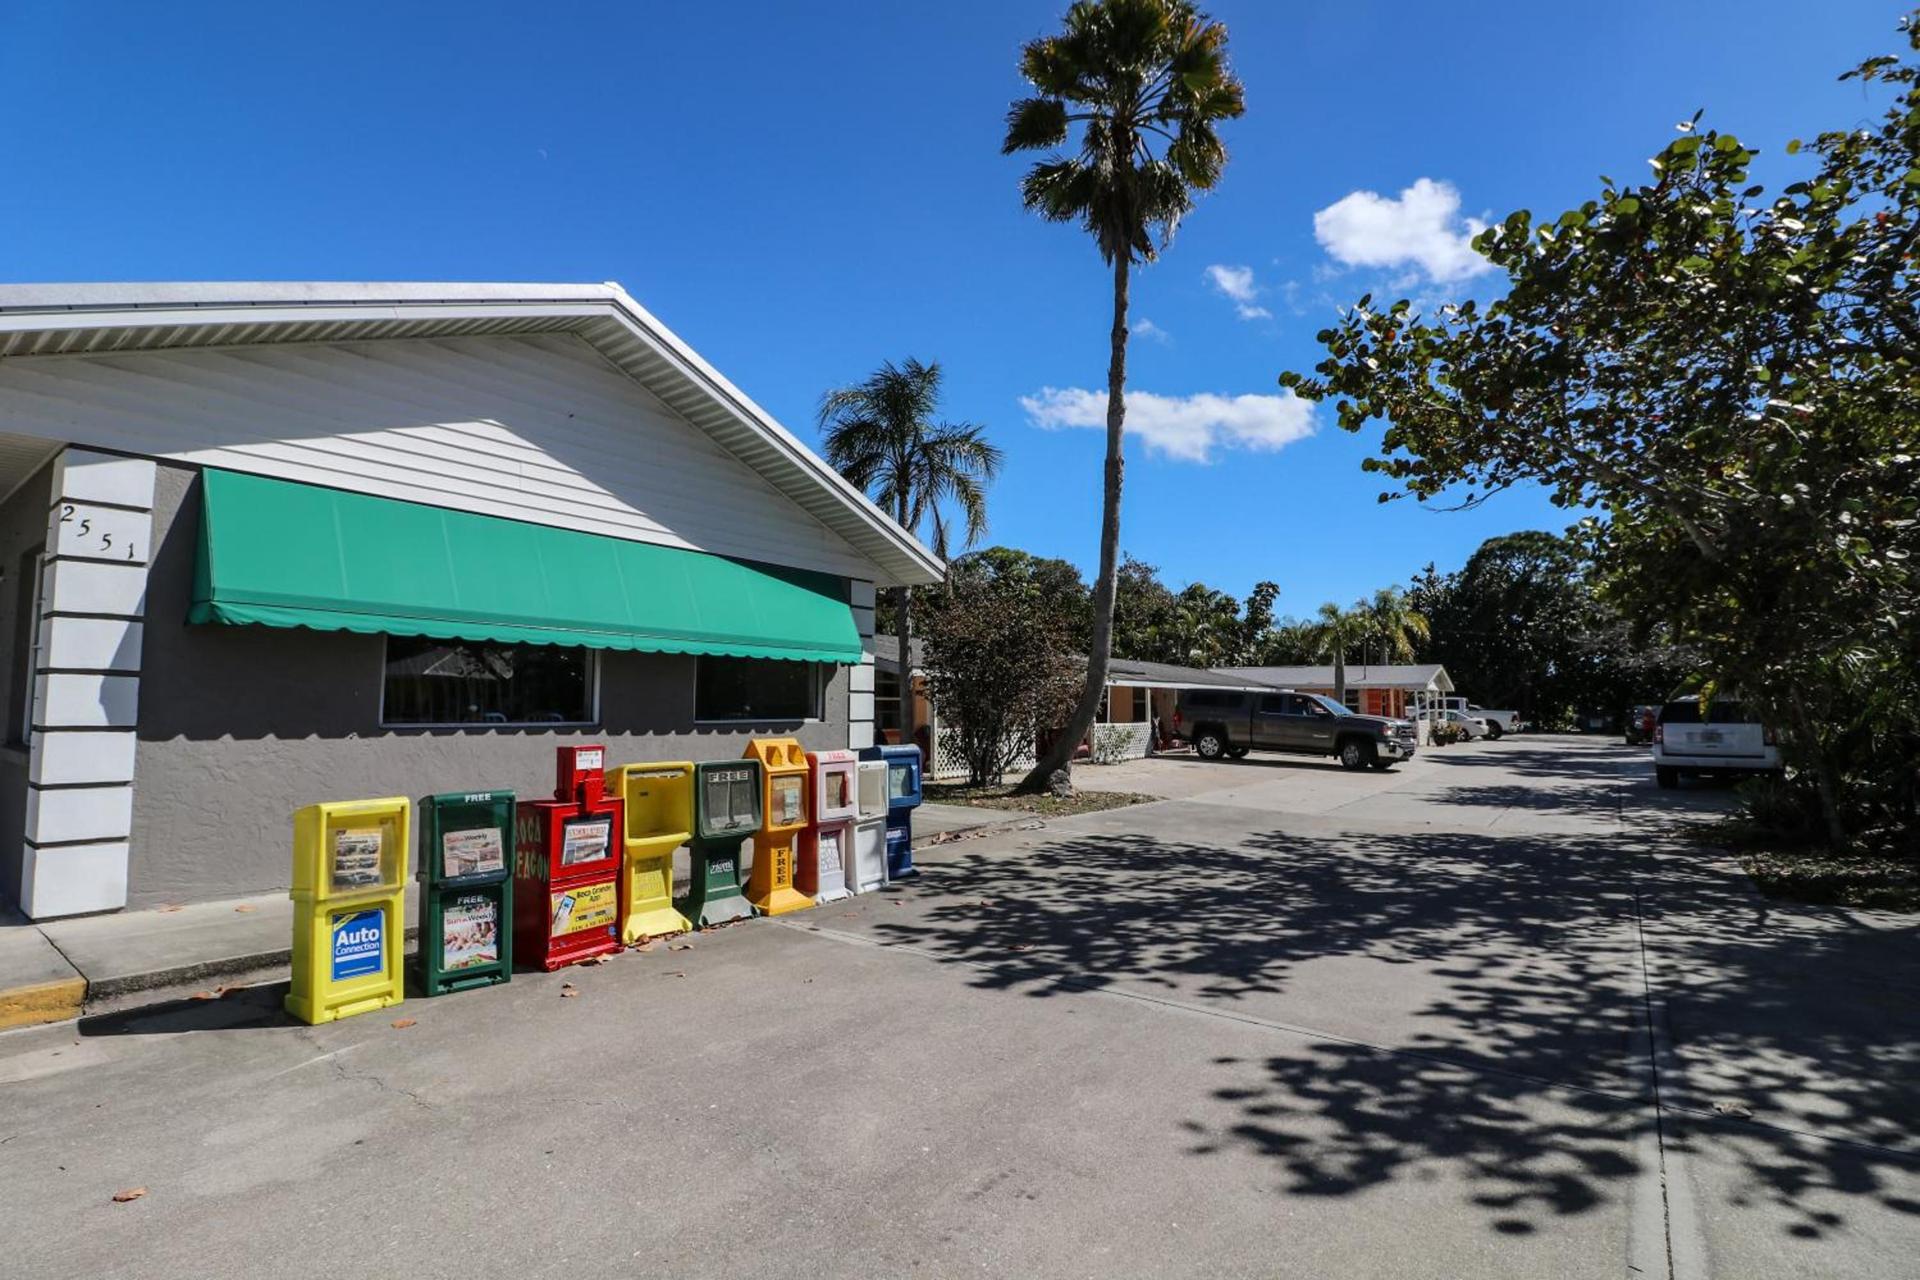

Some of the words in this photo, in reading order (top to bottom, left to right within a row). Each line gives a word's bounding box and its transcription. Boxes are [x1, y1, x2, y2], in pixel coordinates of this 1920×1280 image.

[60, 505, 134, 560] 2551
[707, 770, 749, 783] FREE
[464, 792, 492, 803] FREE
[512, 849, 550, 883] EACON
[776, 849, 786, 884] FREE
[457, 895, 484, 905] FREE
[468, 910, 496, 922] Weekly
[335, 927, 380, 948] Auto
[335, 942, 380, 956] Connection
